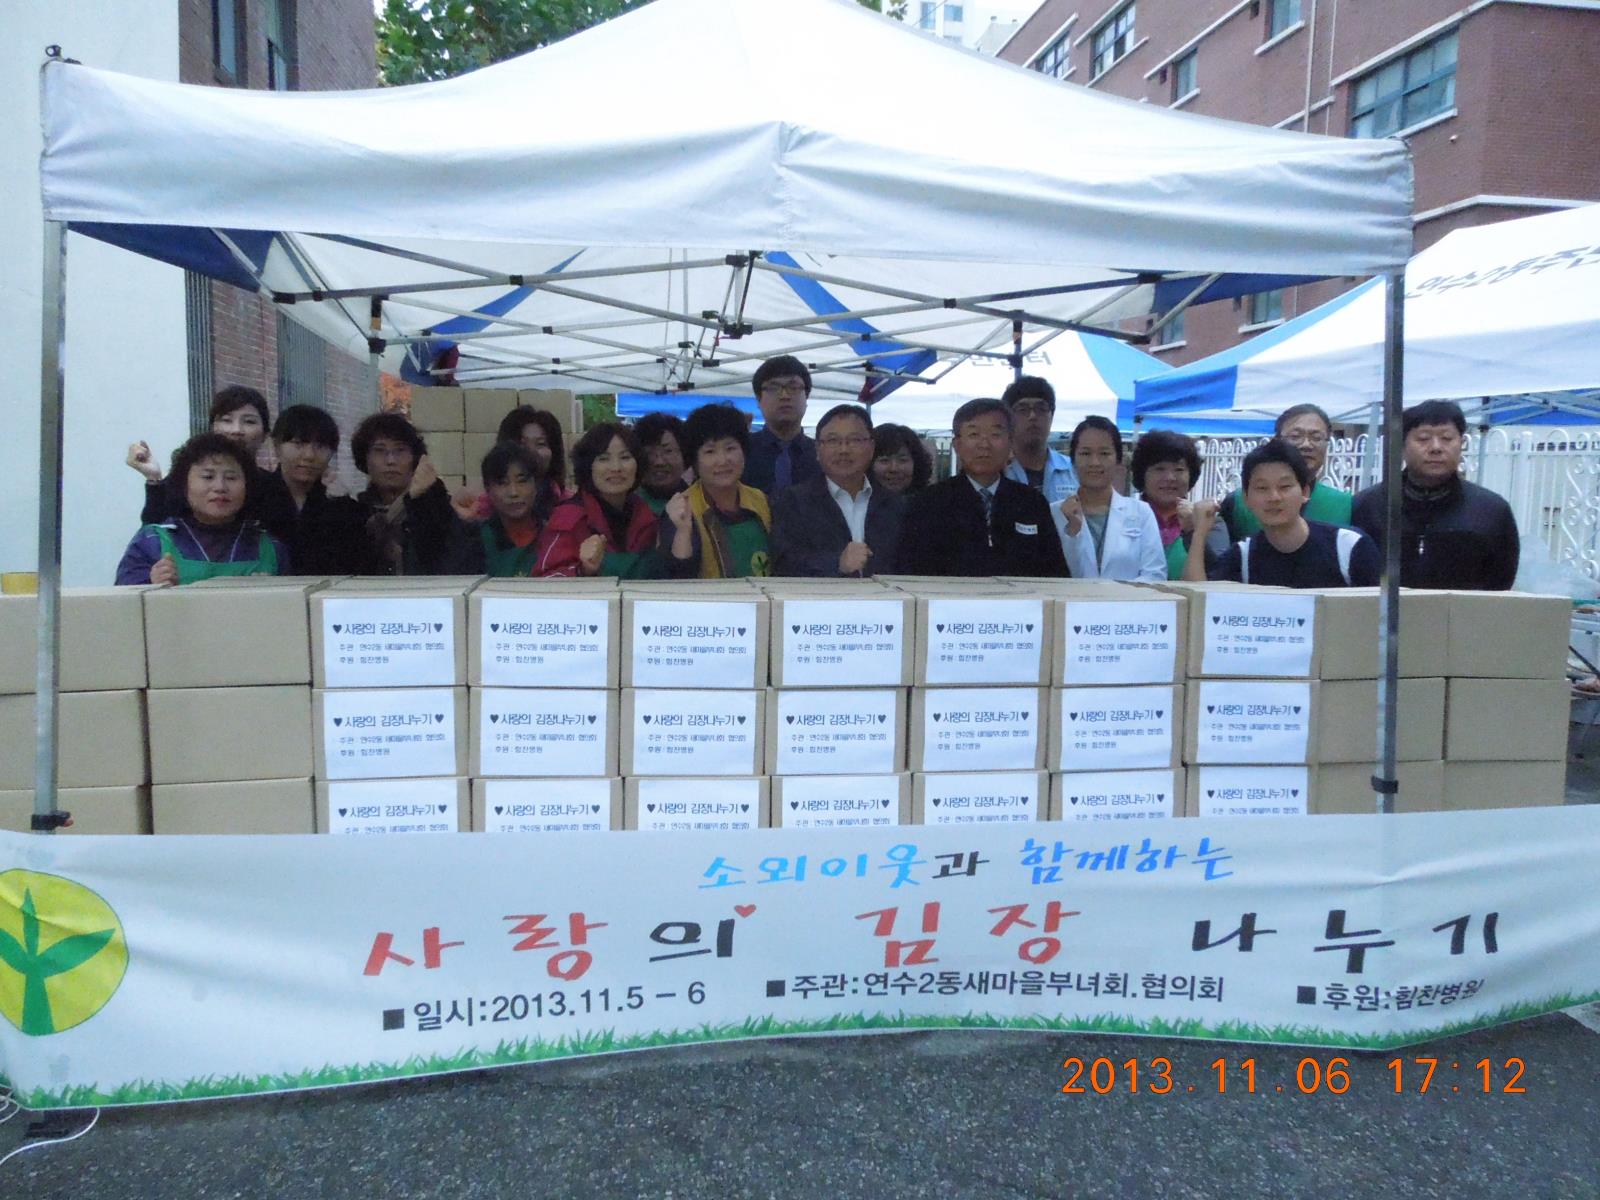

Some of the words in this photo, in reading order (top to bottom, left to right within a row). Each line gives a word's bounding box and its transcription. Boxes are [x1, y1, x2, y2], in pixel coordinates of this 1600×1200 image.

[1222, 616, 1248, 627] 사랑의
[1253, 616, 1295, 628] 김장나누기
[345, 624, 375, 635] 사랑의
[381, 623, 431, 634] 김장나누기
[502, 623, 532, 635] 사랑의
[537, 623, 586, 636] 김장나누기
[653, 625, 682, 637] 사랑의
[687, 626, 735, 638] 김장나누기
[803, 624, 831, 636] 사랑의
[836, 624, 883, 635] 김장나누기
[947, 623, 974, 634] 사랑의
[979, 623, 1023, 634] 김장나누기
[1084, 625, 1110, 636] 사랑의
[1115, 624, 1158, 635] 김장나누기
[1080, 711, 1106, 722] 사랑의
[1111, 710, 1153, 721] 김장나누기
[1217, 705, 1243, 716] 사랑의
[1248, 705, 1291, 716] 김장나누기
[345, 716, 376, 728] 사랑의
[382, 714, 432, 726] 김장나누기
[501, 714, 531, 725] 사랑의
[536, 714, 585, 726] 김장나누기
[654, 715, 682, 726] 사랑의
[688, 715, 735, 726] 김장나누기
[797, 715, 825, 726] 사랑의
[830, 714, 876, 725] 김장나누기
[943, 712, 970, 723] 사랑의
[975, 711, 1019, 722] 김장나누기
[1080, 795, 1107, 806] 사랑의
[1112, 794, 1155, 805] 김장나누기
[1217, 789, 1242, 800] 사랑의
[1247, 789, 1289, 799] 김장나누기
[801, 800, 829, 811] 사랑의
[834, 799, 879, 810] 김장나누기
[943, 797, 970, 808] 사랑의
[974, 796, 1018, 807] 김장나누기
[350, 806, 380, 818] 사랑의
[386, 804, 435, 816] 김장나누기
[506, 805, 535, 816] 사랑의
[541, 804, 589, 815] 김장나누기
[658, 803, 686, 814] 사랑의
[692, 803, 738, 814] 김장나누기
[699, 844, 990, 888] 소외이웃과
[1020, 838, 1234, 884] 함께하는
[1192, 910, 1498, 973] 나누기
